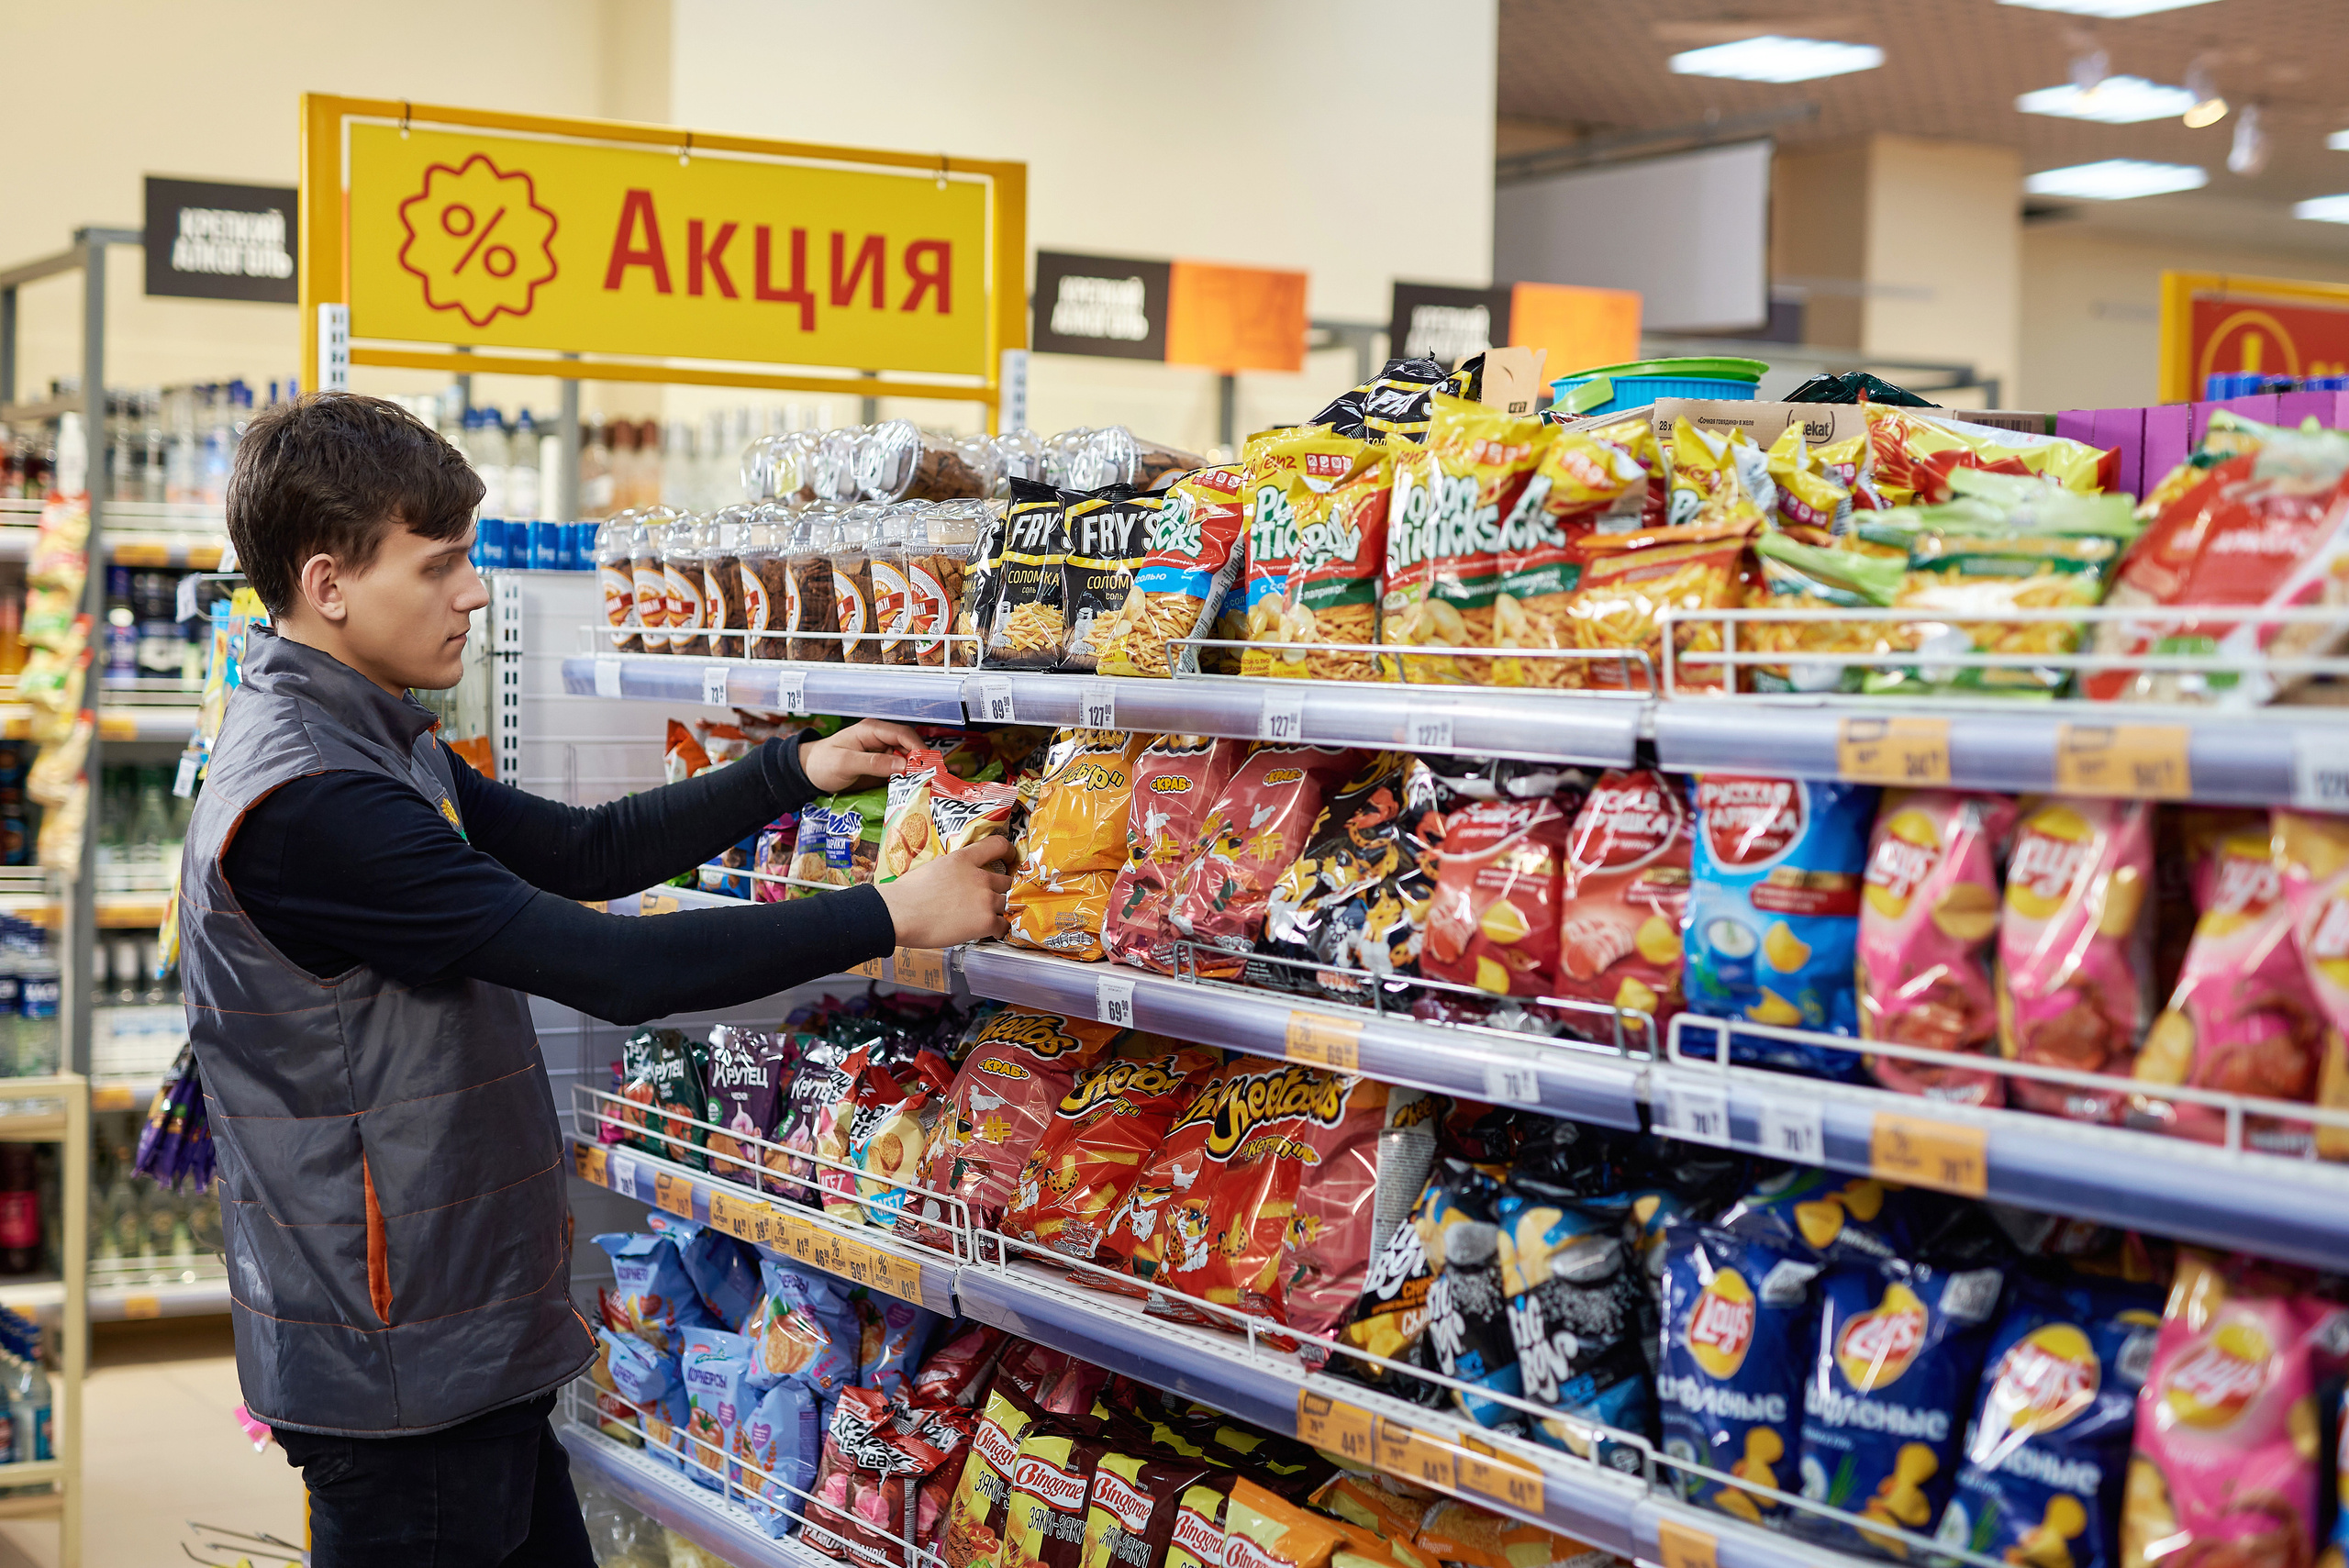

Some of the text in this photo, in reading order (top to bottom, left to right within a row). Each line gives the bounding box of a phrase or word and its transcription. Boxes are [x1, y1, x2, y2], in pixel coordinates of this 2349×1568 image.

[603, 188, 952, 333] Акция
[1081, 509, 1163, 556] FRY'S
[1008, 570, 1061, 587] СОЛОМКА
[1304, 584, 1348, 600] паприкой
[786, 692, 796, 709] 73
[992, 699, 1004, 720] 89
[1088, 706, 1104, 727] 127
[1270, 716, 1288, 737] 127
[931, 796, 996, 817] ХРУС
[934, 816, 968, 837] team
[1108, 1000, 1122, 1022] 69
[712, 1062, 769, 1089] КРУТЕЦ
[979, 1058, 1029, 1078] «КРАБ»
[755, 1221, 765, 1240] 39
[796, 1238, 805, 1257] 41
[815, 1248, 825, 1267] 46
[851, 1261, 863, 1281] 59
[901, 1280, 912, 1300] 41
[975, 1427, 1017, 1467] Binggr
[1341, 1432, 1356, 1455] 44
[1016, 1462, 1085, 1500] Binggrae
[1092, 1477, 1151, 1521] Binggrae
